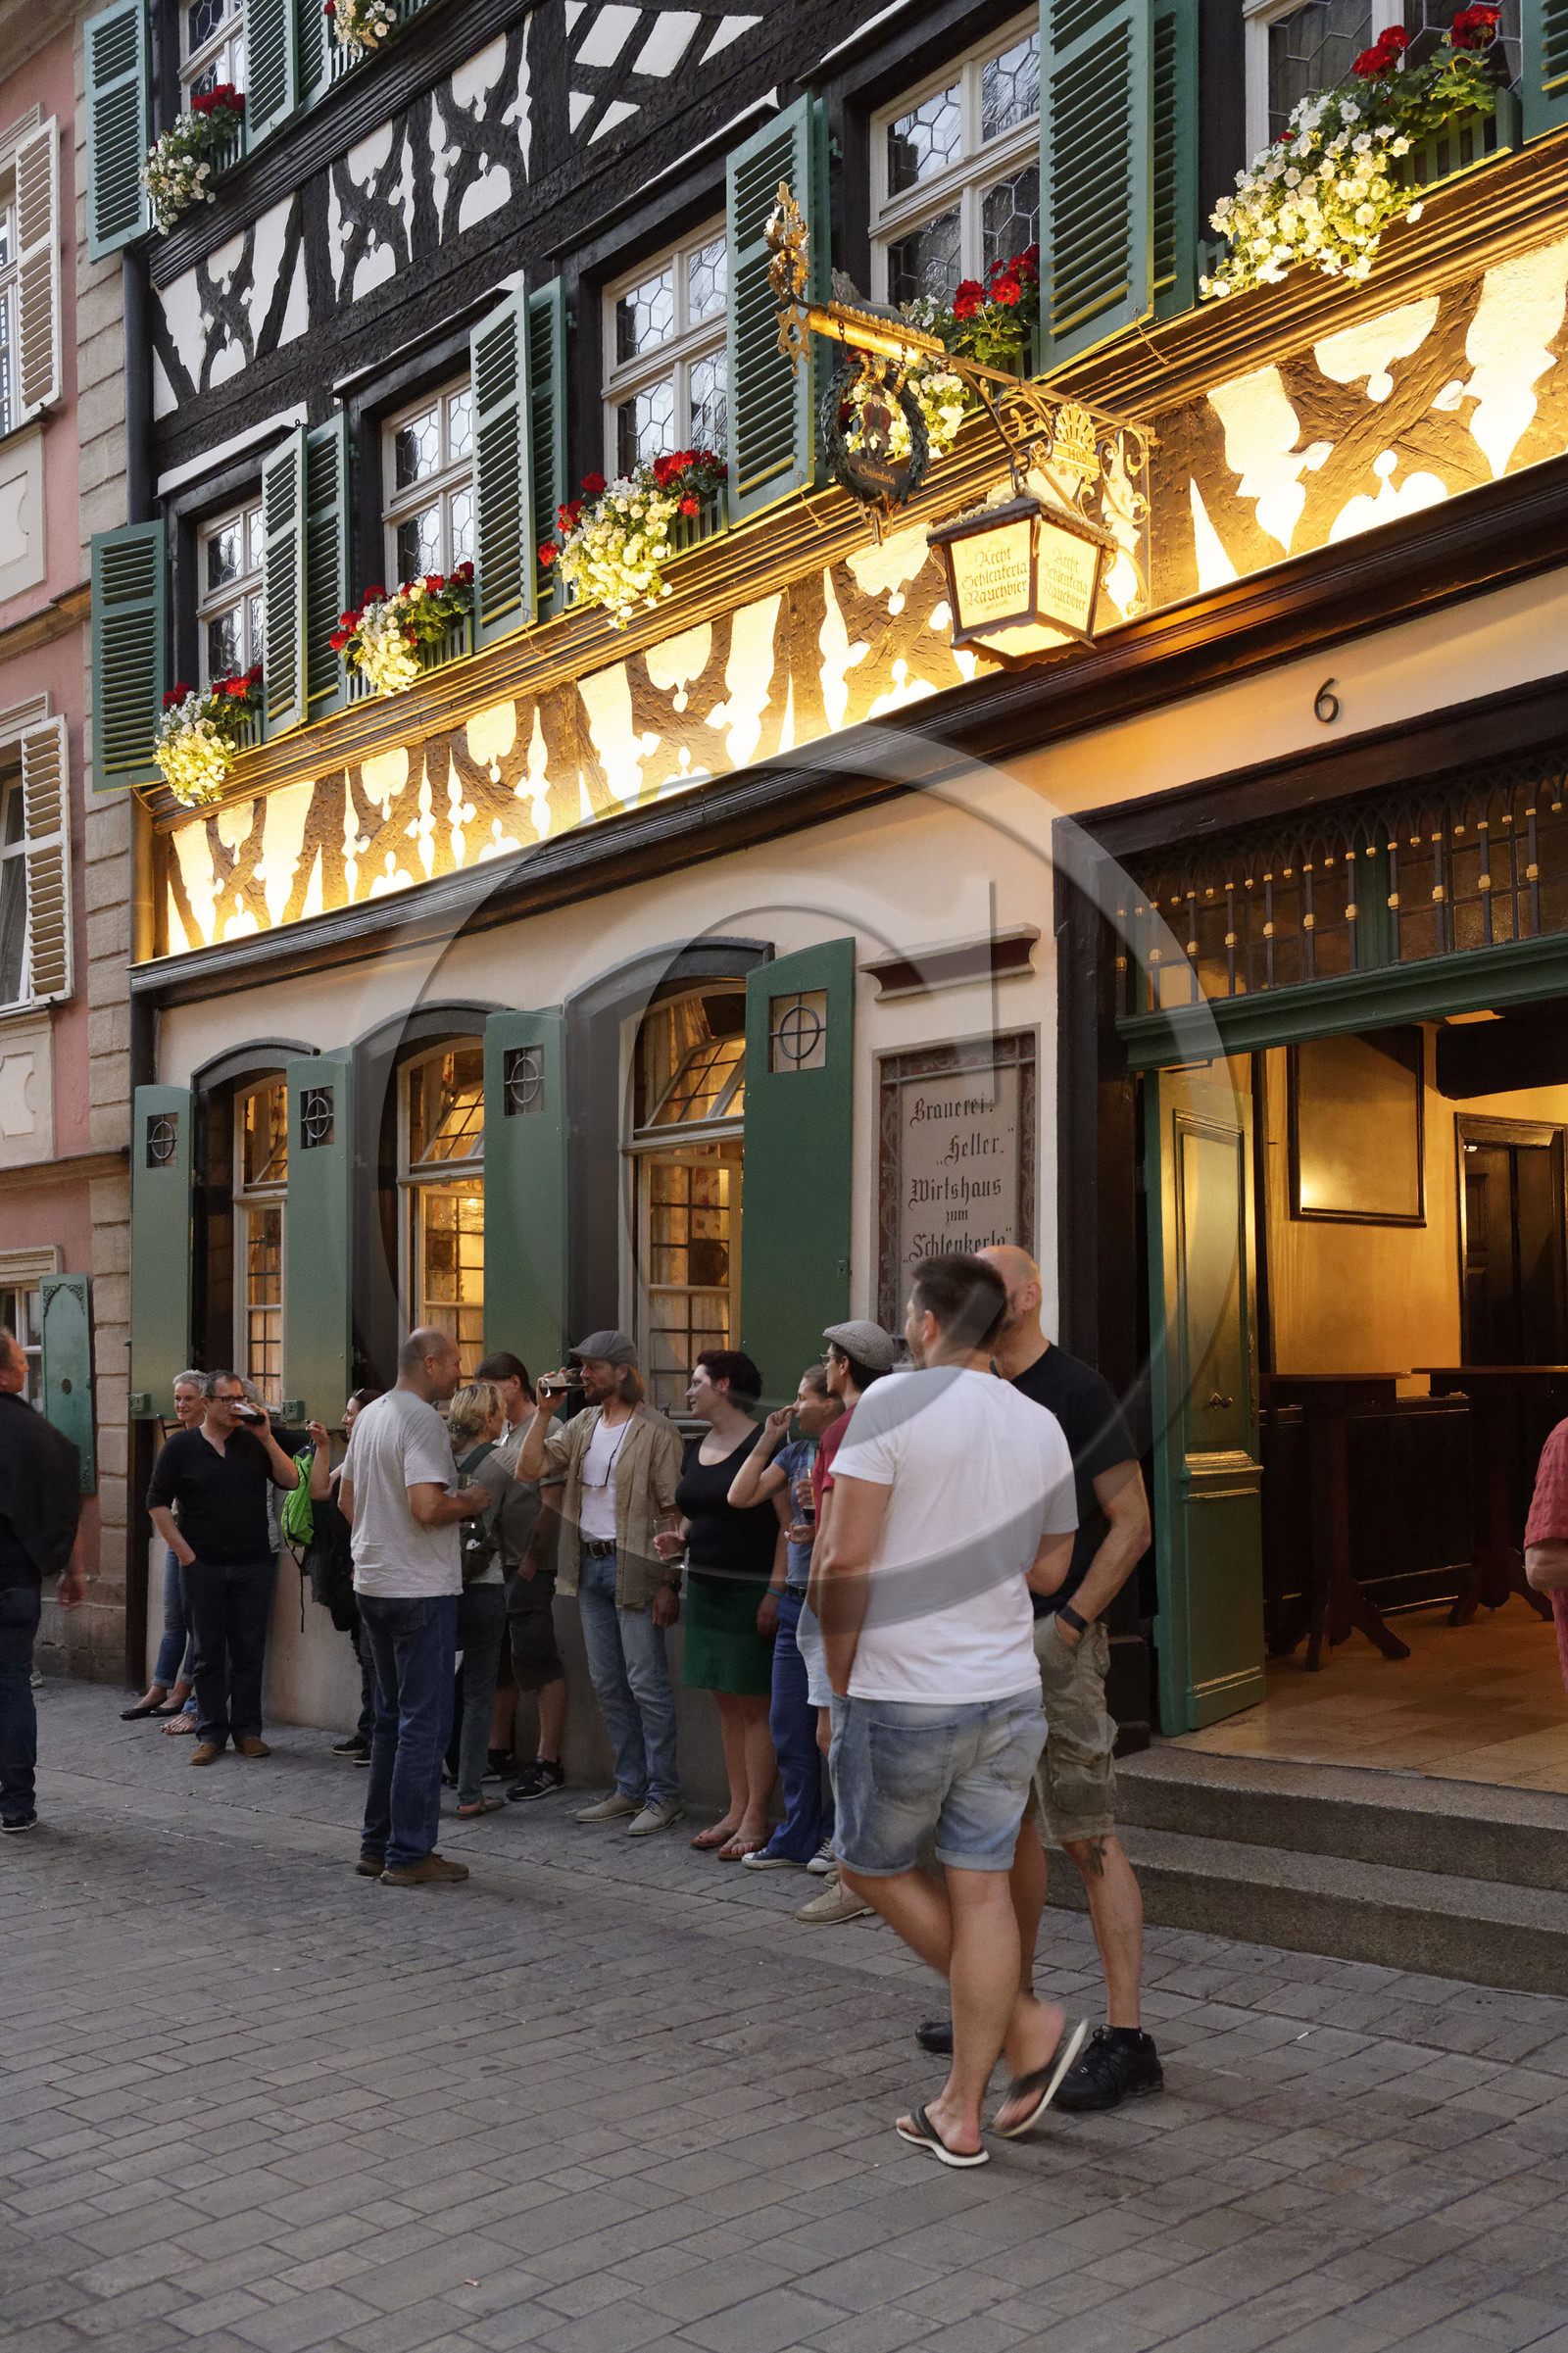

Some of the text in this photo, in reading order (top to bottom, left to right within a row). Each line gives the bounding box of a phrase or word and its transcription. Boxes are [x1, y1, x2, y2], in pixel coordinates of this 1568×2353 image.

[974, 546, 1010, 566] Aecht
[961, 562, 1027, 590] Schlenkerla
[963, 580, 1027, 608] Rauchbier
[1314, 677, 1340, 723] 6
[907, 1176, 1002, 1210] Wirtshaus
[945, 1209, 969, 1226] zum
